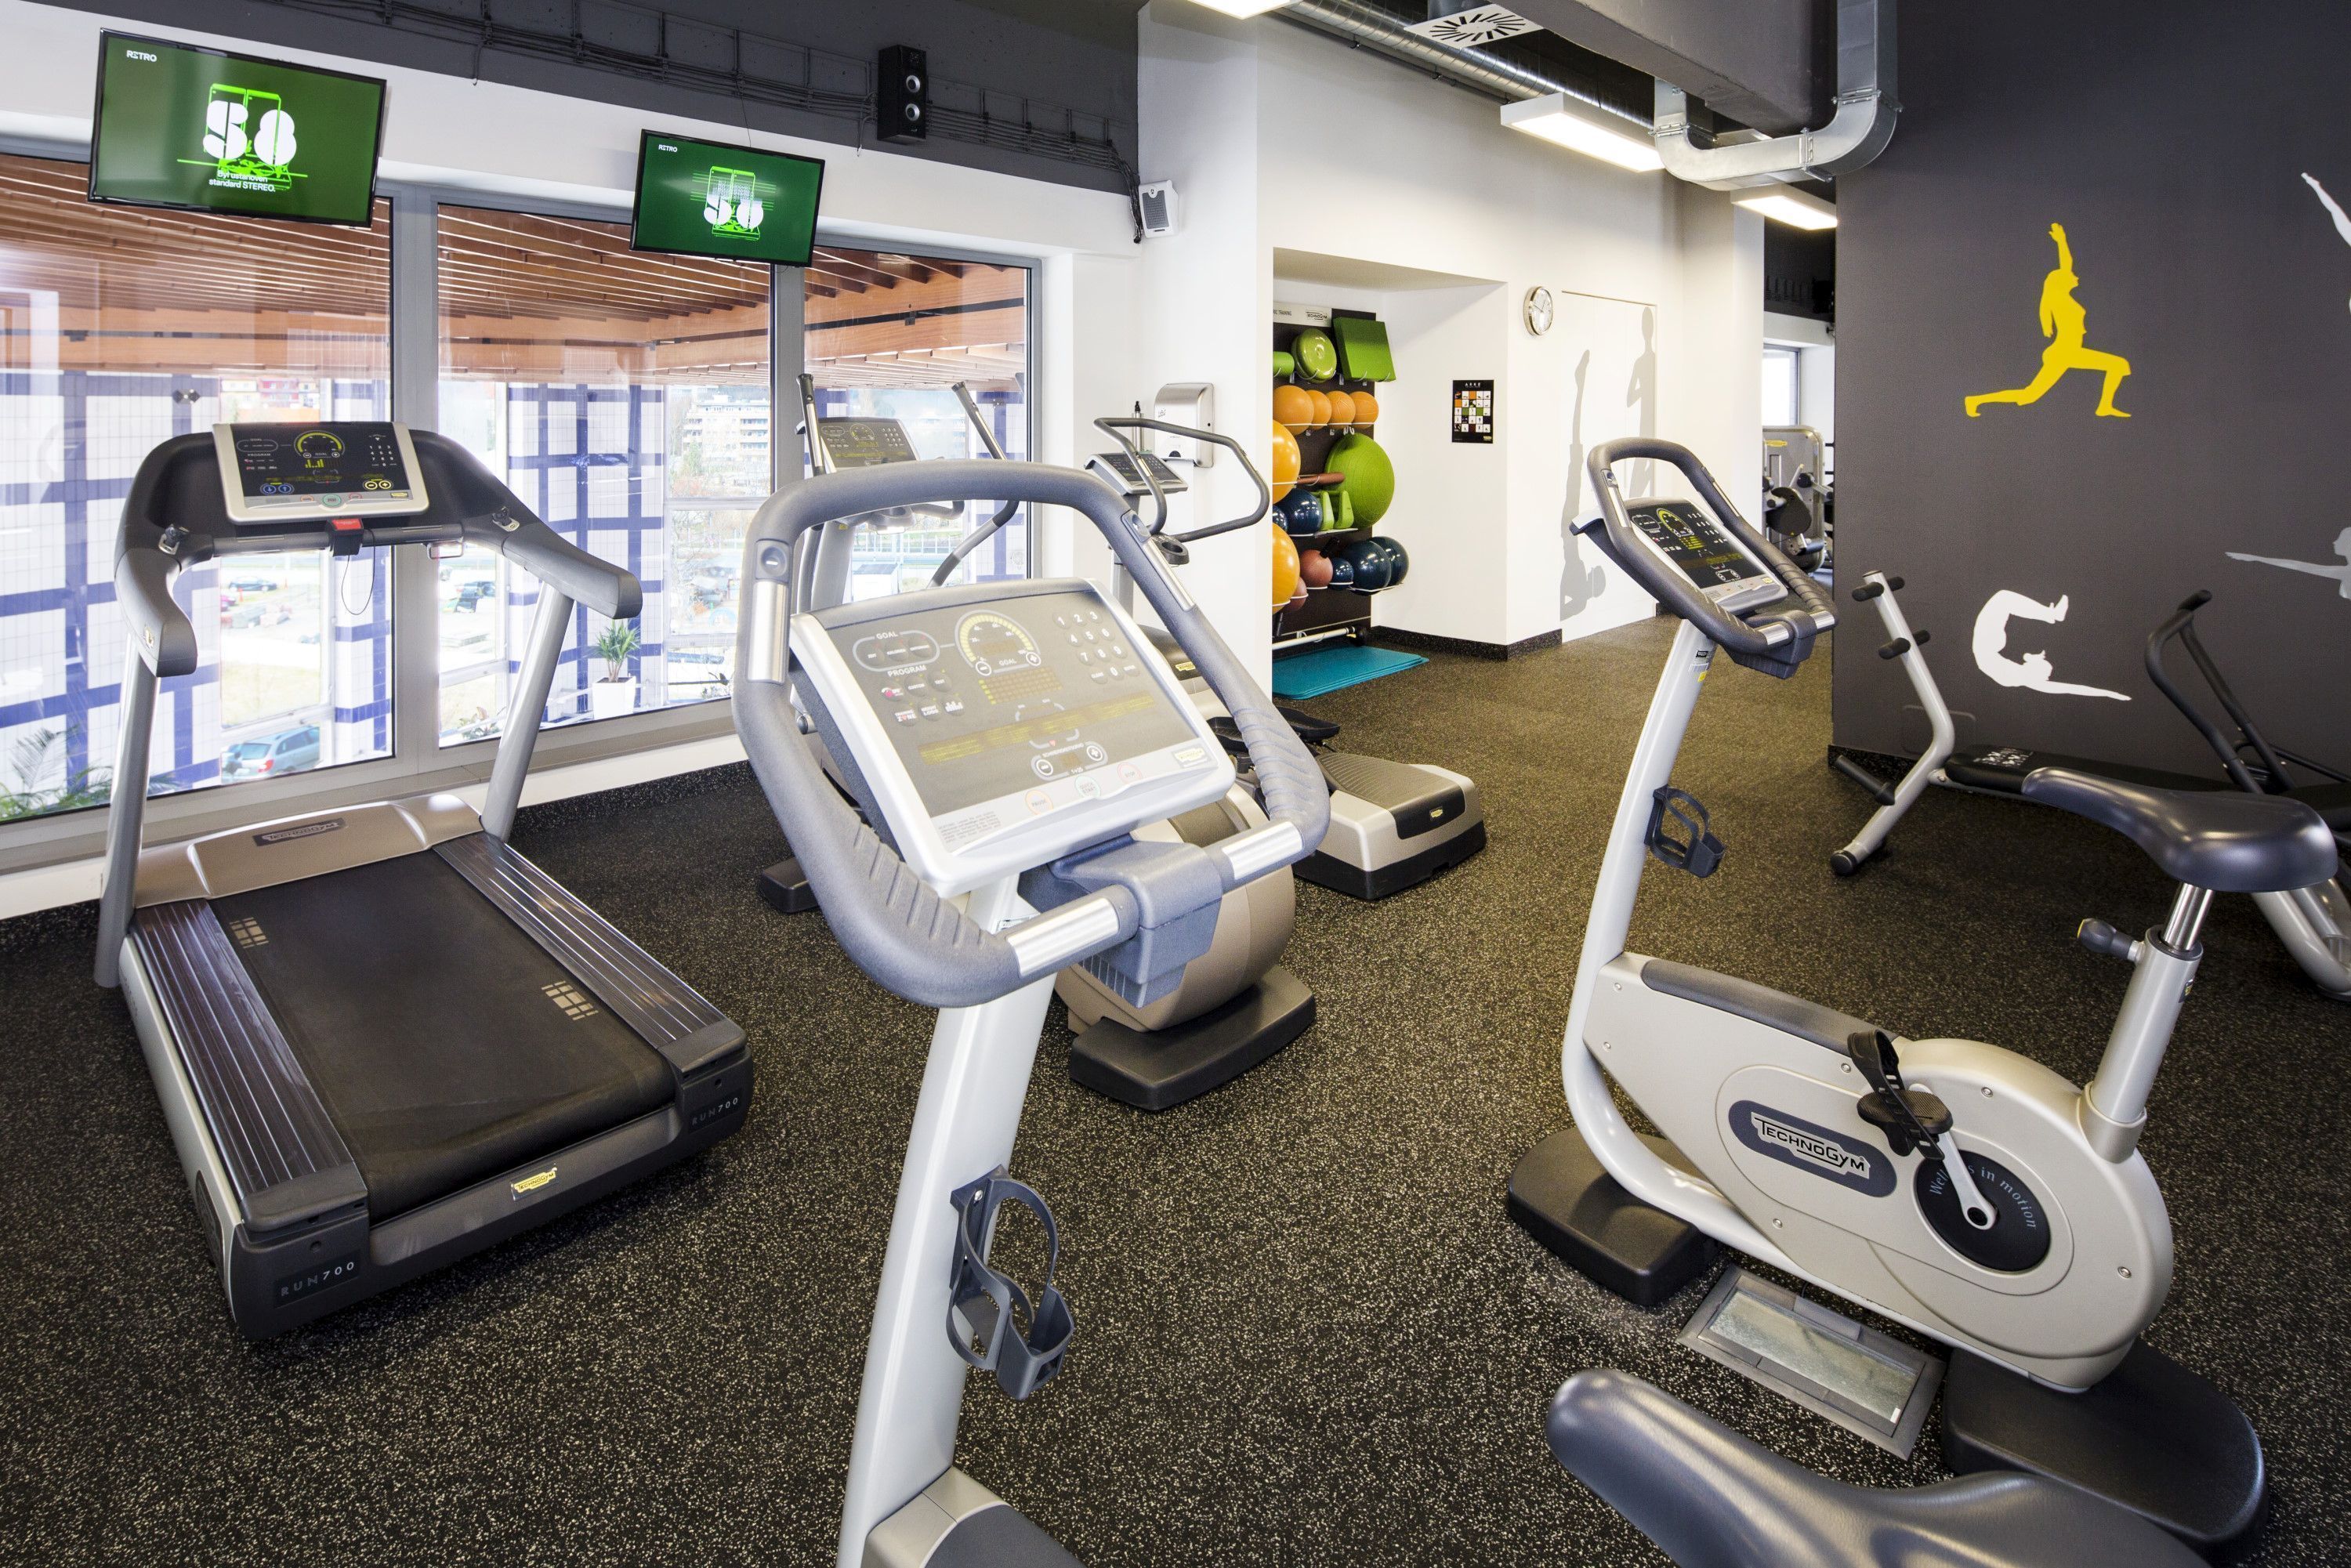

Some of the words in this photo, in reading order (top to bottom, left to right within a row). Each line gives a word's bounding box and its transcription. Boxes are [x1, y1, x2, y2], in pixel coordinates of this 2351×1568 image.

[126, 49, 158, 63] RETRO
[658, 143, 678, 153] RETRO
[208, 179, 241, 189] standard
[242, 181, 276, 193] STEREO.
[1057, 616, 1065, 625] 1
[1074, 614, 1083, 623] 2
[1089, 611, 1098, 620] 3
[876, 631, 899, 640] GOAL
[1070, 634, 1078, 643] 4
[1085, 631, 1094, 640] 5
[1101, 628, 1110, 637] 6
[1080, 652, 1089, 661] 7
[1097, 649, 1106, 658] 8
[1113, 645, 1122, 655] 9
[886, 664, 927, 677] PROGRAM
[1110, 666, 1118, 676] 0
[1754, 1117, 1865, 1172] TECHNOGYM
[516, 1172, 554, 1190] TECHNOGYM
[1980, 1166, 1996, 1182] in
[1999, 1179, 2038, 1230] motion
